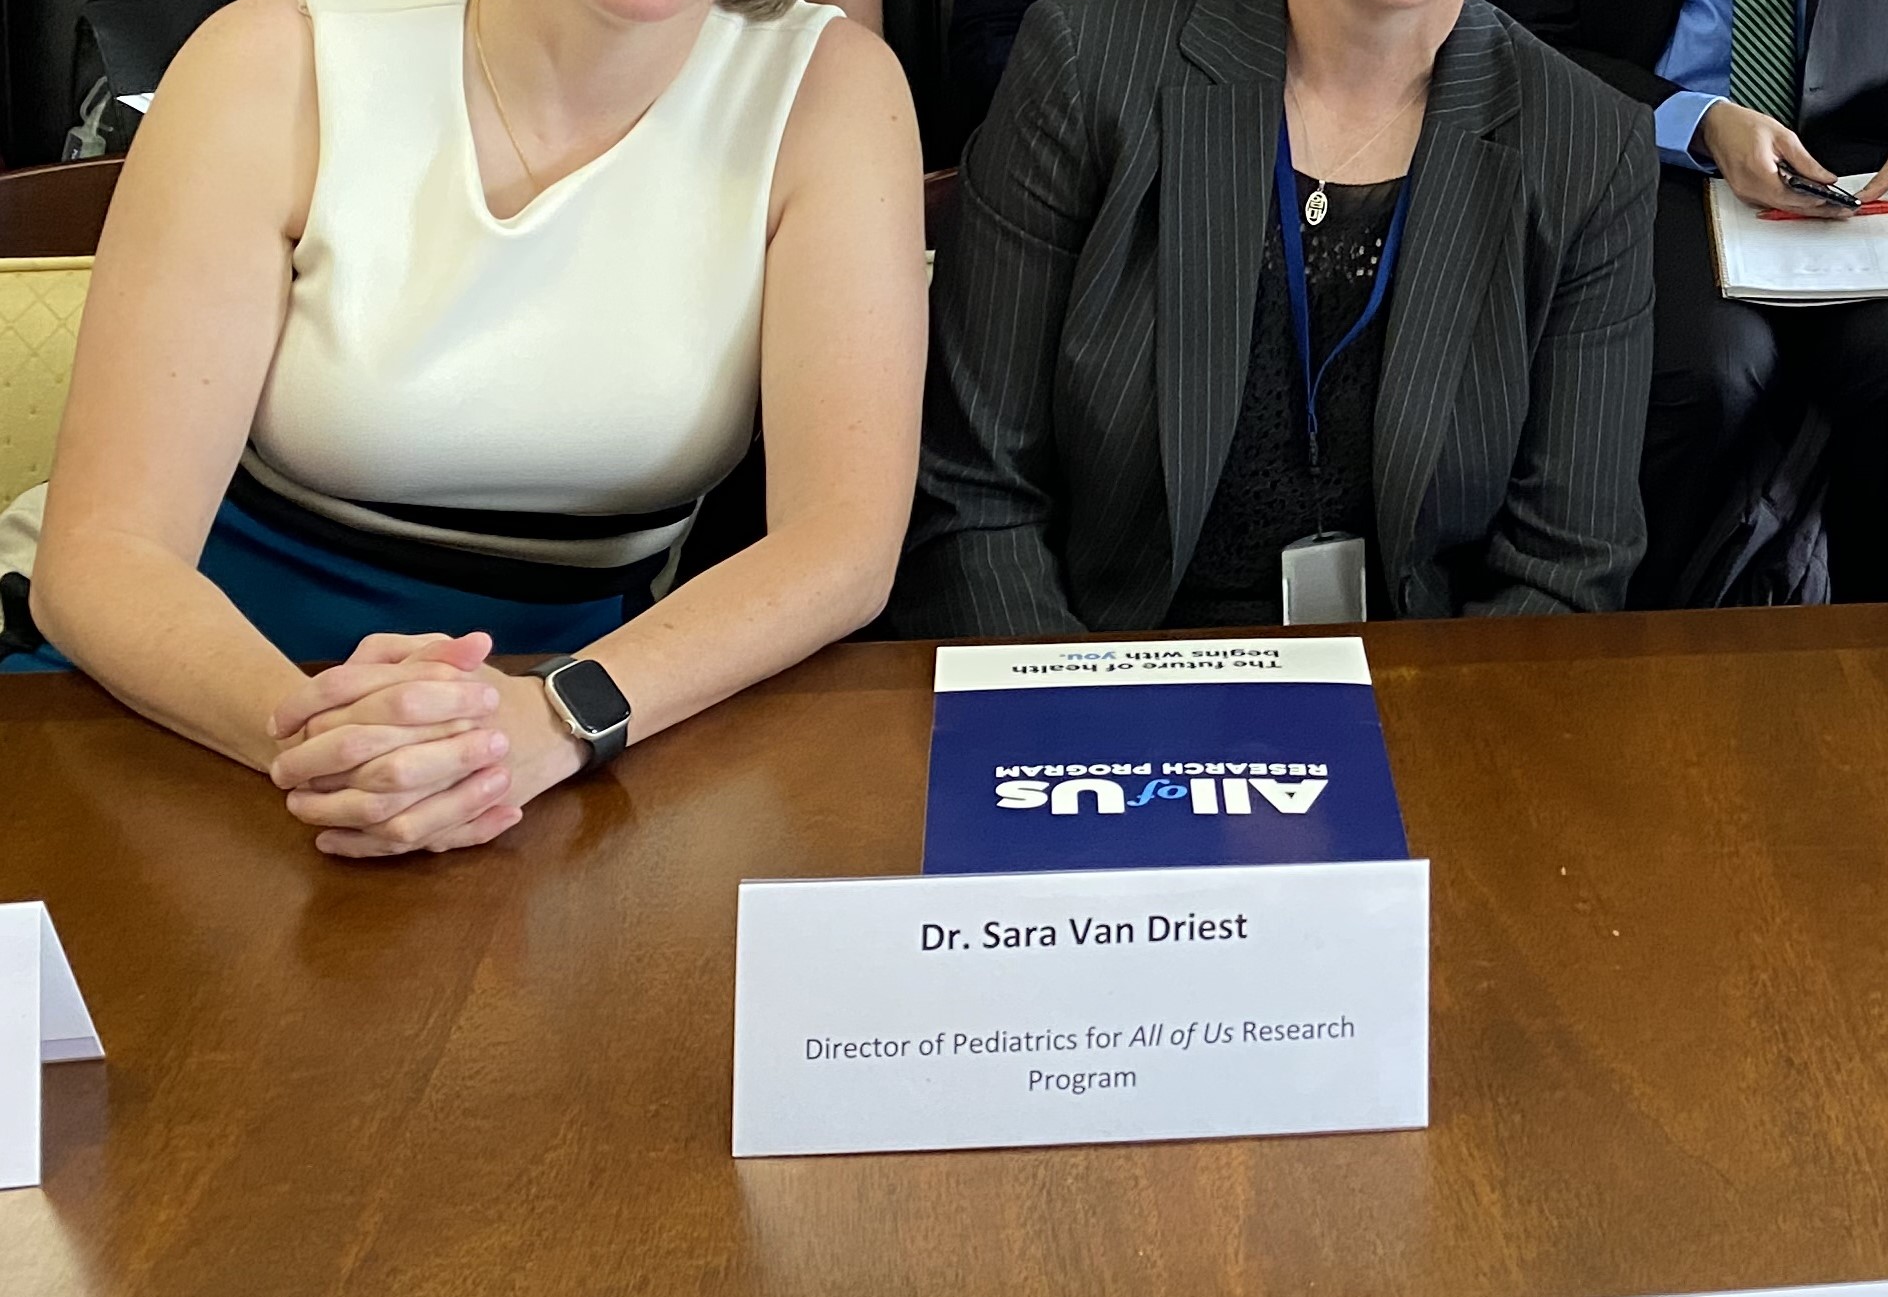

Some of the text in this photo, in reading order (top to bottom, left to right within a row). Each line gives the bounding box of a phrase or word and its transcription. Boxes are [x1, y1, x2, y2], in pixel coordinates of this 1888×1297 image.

[1012, 660, 1282, 674] The future of health
[1059, 648, 1280, 661] begins with you.
[995, 762, 1329, 778] RESEARCH PROGRAM
[995, 777, 1329, 815] All of Us
[921, 912, 1248, 951] Dr. Sara Van Driest
[806, 1015, 1355, 1060] Director of Pediatrics for All of Us Research
[1029, 1069, 1137, 1096] Program
